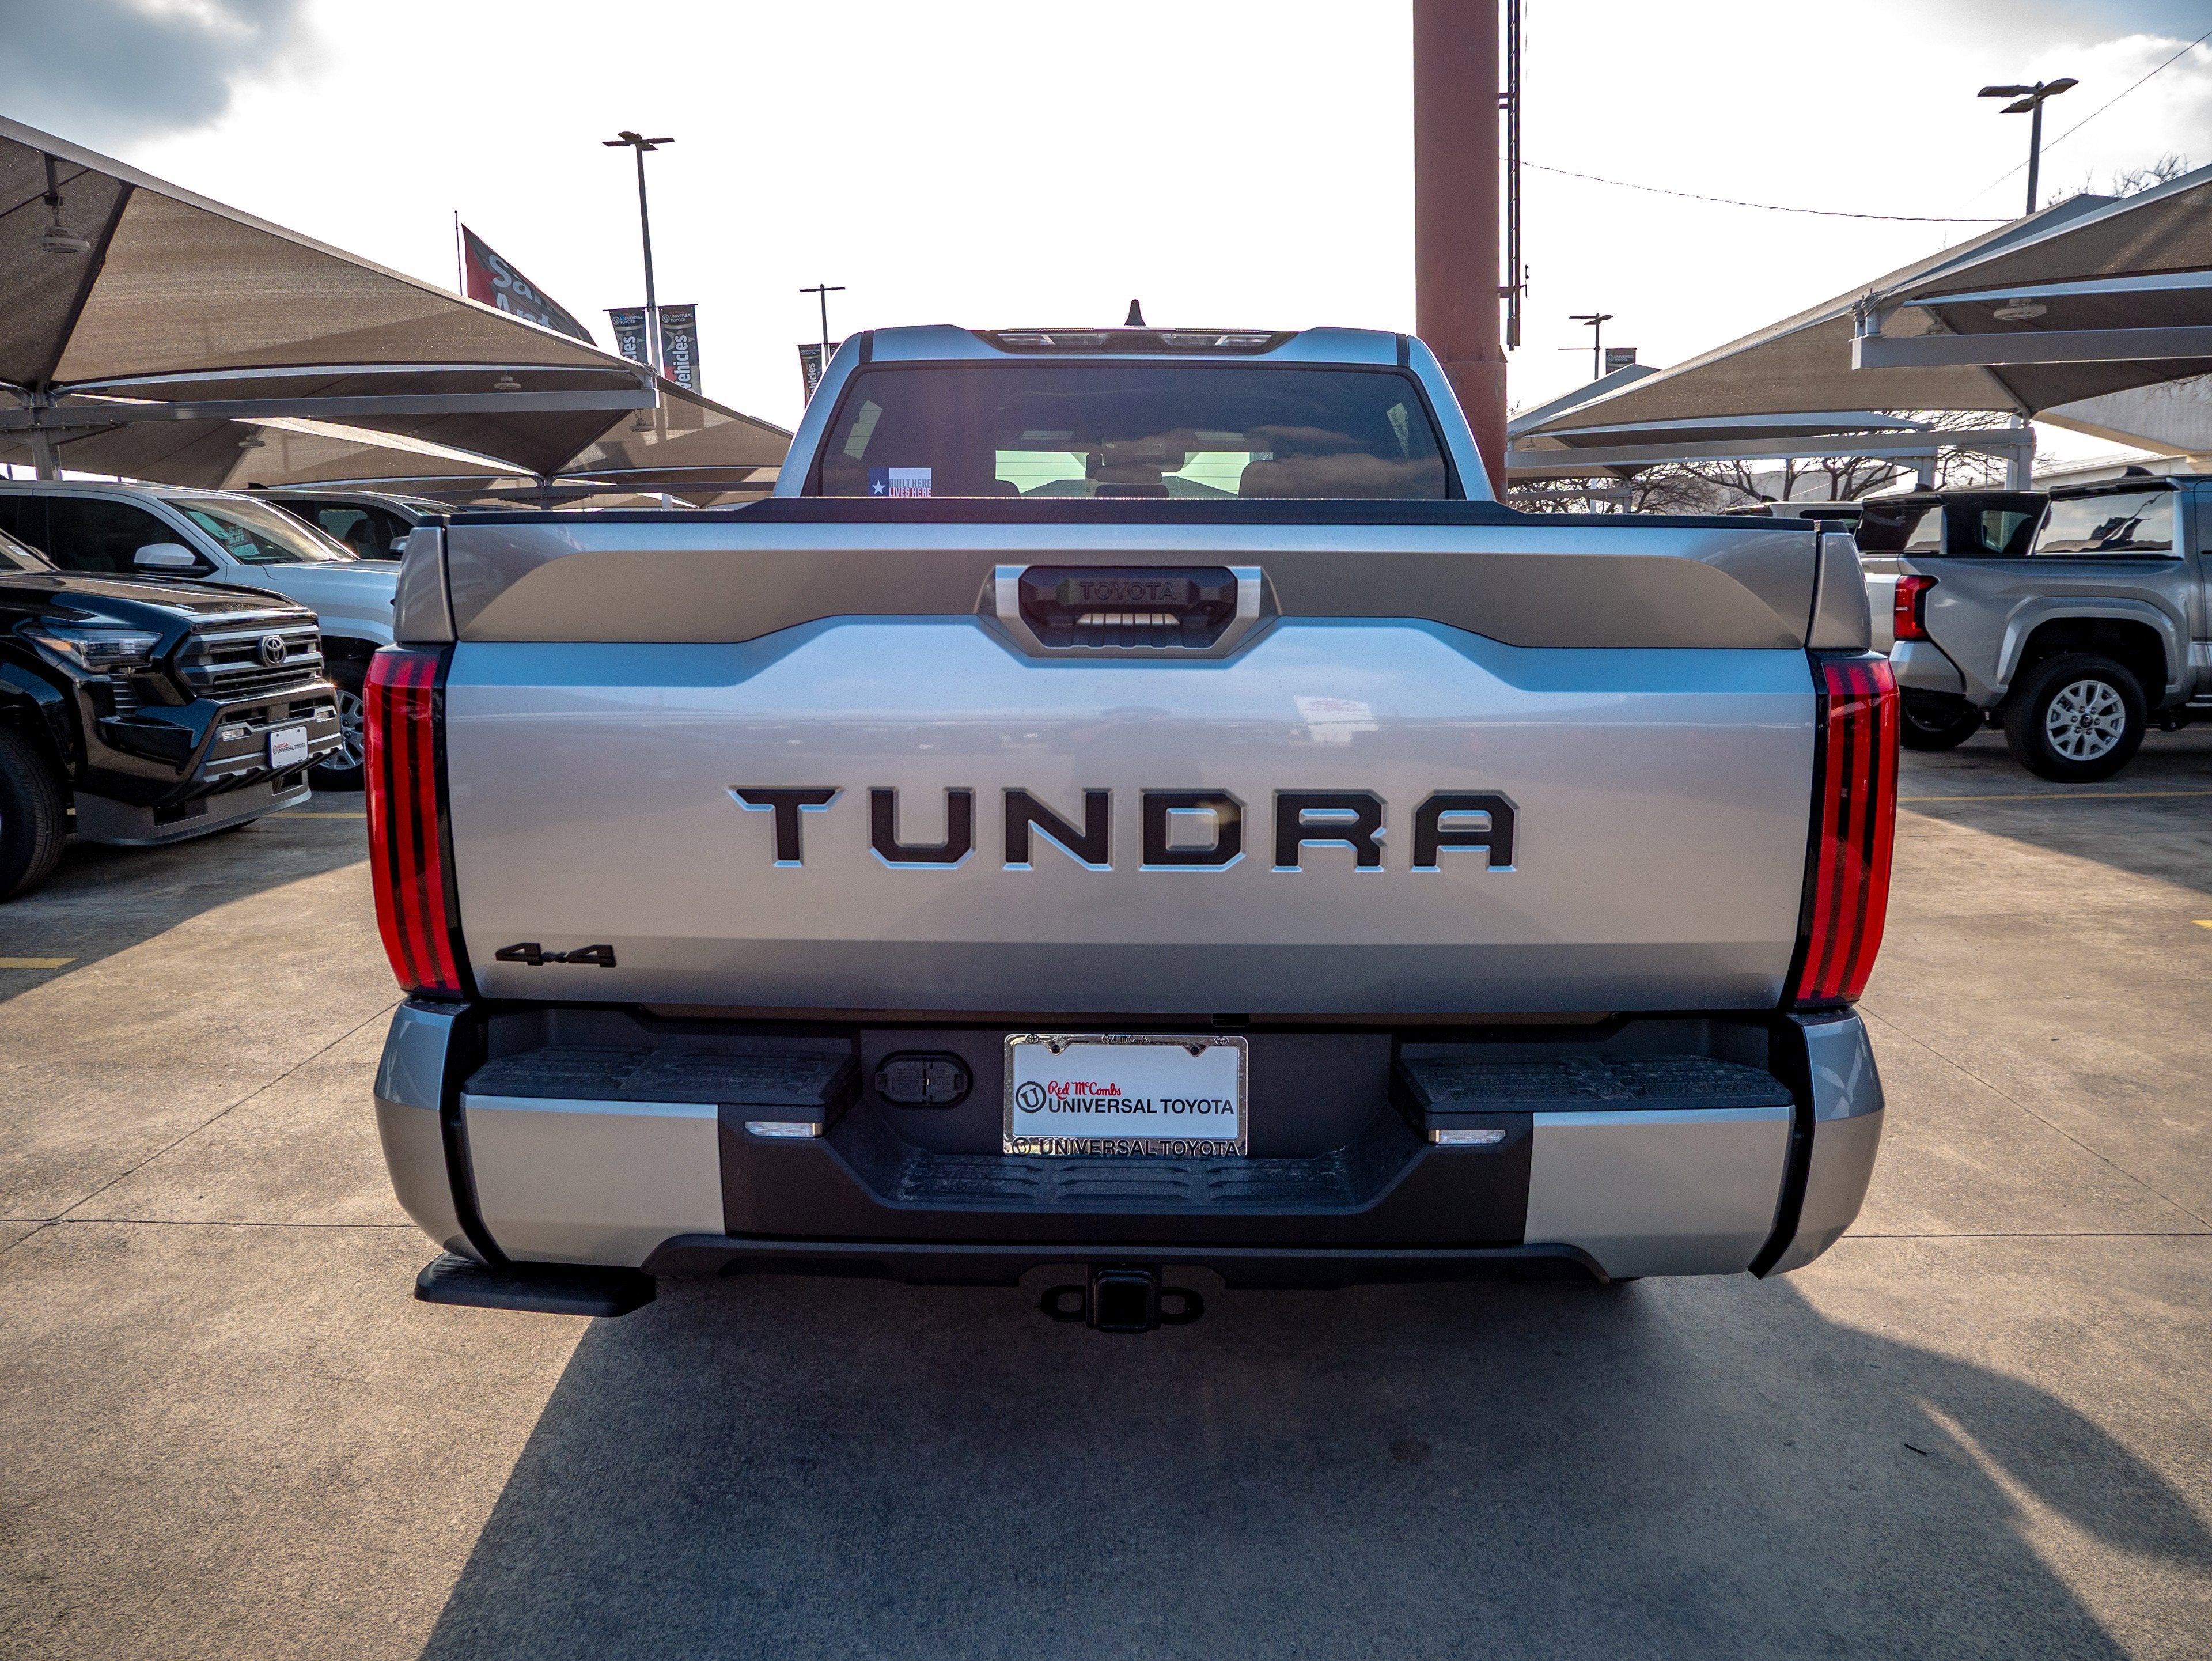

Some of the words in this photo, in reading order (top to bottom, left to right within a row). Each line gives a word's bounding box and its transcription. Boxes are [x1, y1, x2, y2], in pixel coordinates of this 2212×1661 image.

[889, 479, 910, 488] BUILT
[912, 479, 931, 488] HERE
[889, 488, 910, 497] LIVES
[912, 488, 931, 497] HERE
[1080, 581, 1176, 600] TOYOTA
[727, 788, 1517, 872] TUNDRA
[1048, 1081, 1070, 1100] Red
[1071, 1081, 1121, 1095] McCombs
[1048, 1098, 1157, 1114] UNIVERSAL
[1161, 1099, 1234, 1115] TOYOTA
[1039, 1138, 1157, 1156] UNIVERSAL
[1159, 1140, 1240, 1157] TOYOTA
